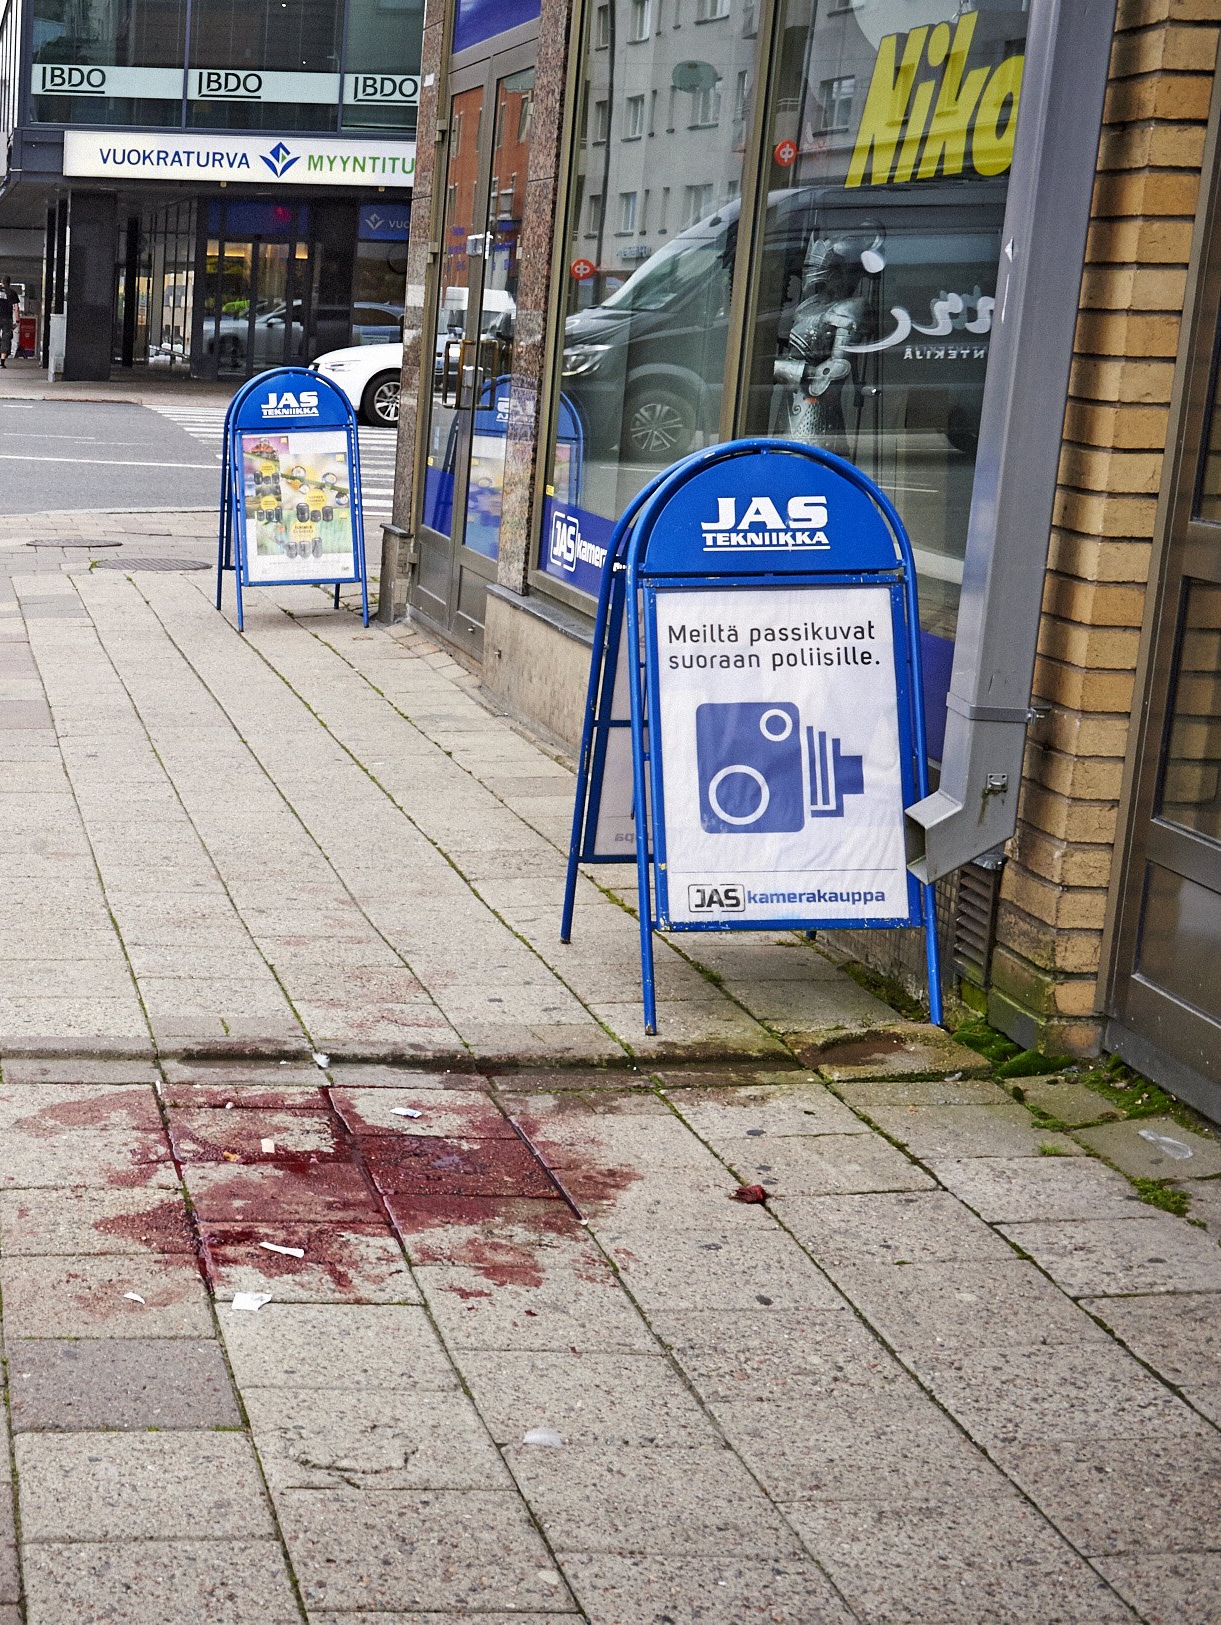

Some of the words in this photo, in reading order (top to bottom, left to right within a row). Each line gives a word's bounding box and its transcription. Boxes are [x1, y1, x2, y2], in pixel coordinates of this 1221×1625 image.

[844, 11, 1026, 188] Niko
[99, 148, 251, 169] VUOKRATURVA
[307, 154, 414, 175] MYYNTITU
[261, 391, 318, 408] JAS
[262, 407, 319, 415] TEKNIIKKA
[700, 496, 829, 531] JAS
[553, 521, 576, 562] JAS
[701, 531, 830, 547] TEKNIIKKA
[668, 624, 739, 644] Meiltä
[749, 620, 876, 647] passikuvat
[668, 653, 761, 670] suoraan
[771, 647, 881, 672] poliisille.
[694, 888, 741, 908] JAS
[747, 889, 886, 905] kamerakauppa
